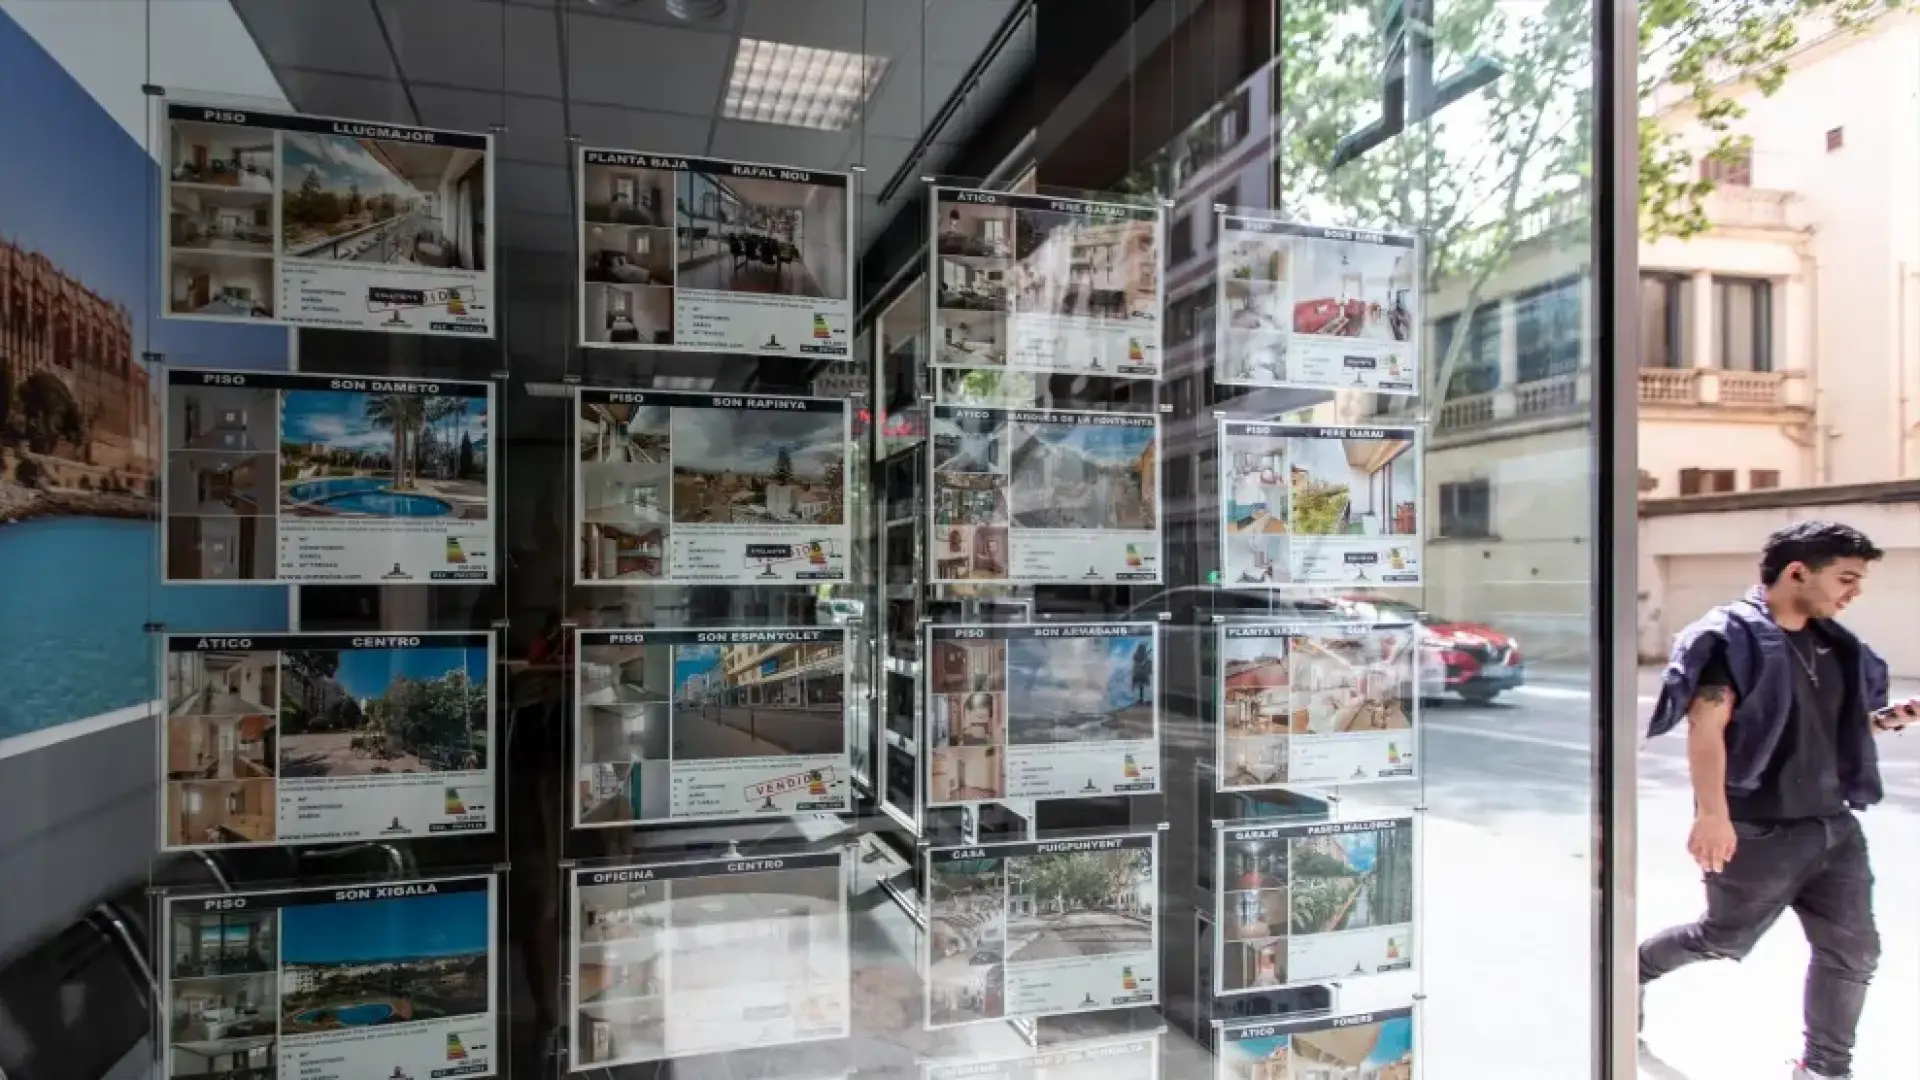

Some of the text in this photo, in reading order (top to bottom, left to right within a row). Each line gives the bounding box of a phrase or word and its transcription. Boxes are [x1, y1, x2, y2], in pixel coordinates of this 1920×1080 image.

[204, 110, 246, 124] PISO
[332, 122, 435, 143] LLUCMAJOR
[588, 152, 689, 170] PLANTA BAJA
[732, 165, 810, 182] RAFAL NOU
[957, 190, 996, 203] ÁTICO
[203, 374, 245, 386] PISO
[330, 379, 440, 394] SON DAMETO
[609, 393, 644, 403] PISO
[712, 397, 807, 410] SON RAPINYA
[1246, 426, 1271, 435] PISO
[1320, 428, 1346, 437] PERE
[697, 631, 821, 643] SON ESPANYOLET
[955, 628, 985, 638] PISO
[1034, 626, 1128, 637] SON ARMADANS
[1229, 628, 1271, 637] PLANTA
[196, 636, 252, 649] ÁTICO
[352, 636, 421, 648] CENTRO
[609, 634, 644, 644] PISO
[1308, 820, 1396, 836] PASEO MALLORCA
[1235, 829, 1279, 840] GARAJE
[1037, 839, 1123, 853] PUIGPUNYENT
[952, 848, 986, 860] CASA
[728, 860, 785, 872] CENTRO
[594, 870, 655, 884] OFICINA
[335, 883, 437, 901] SON XIGALA
[204, 898, 247, 910] PISO
[1240, 1027, 1275, 1038] ÁTICO
